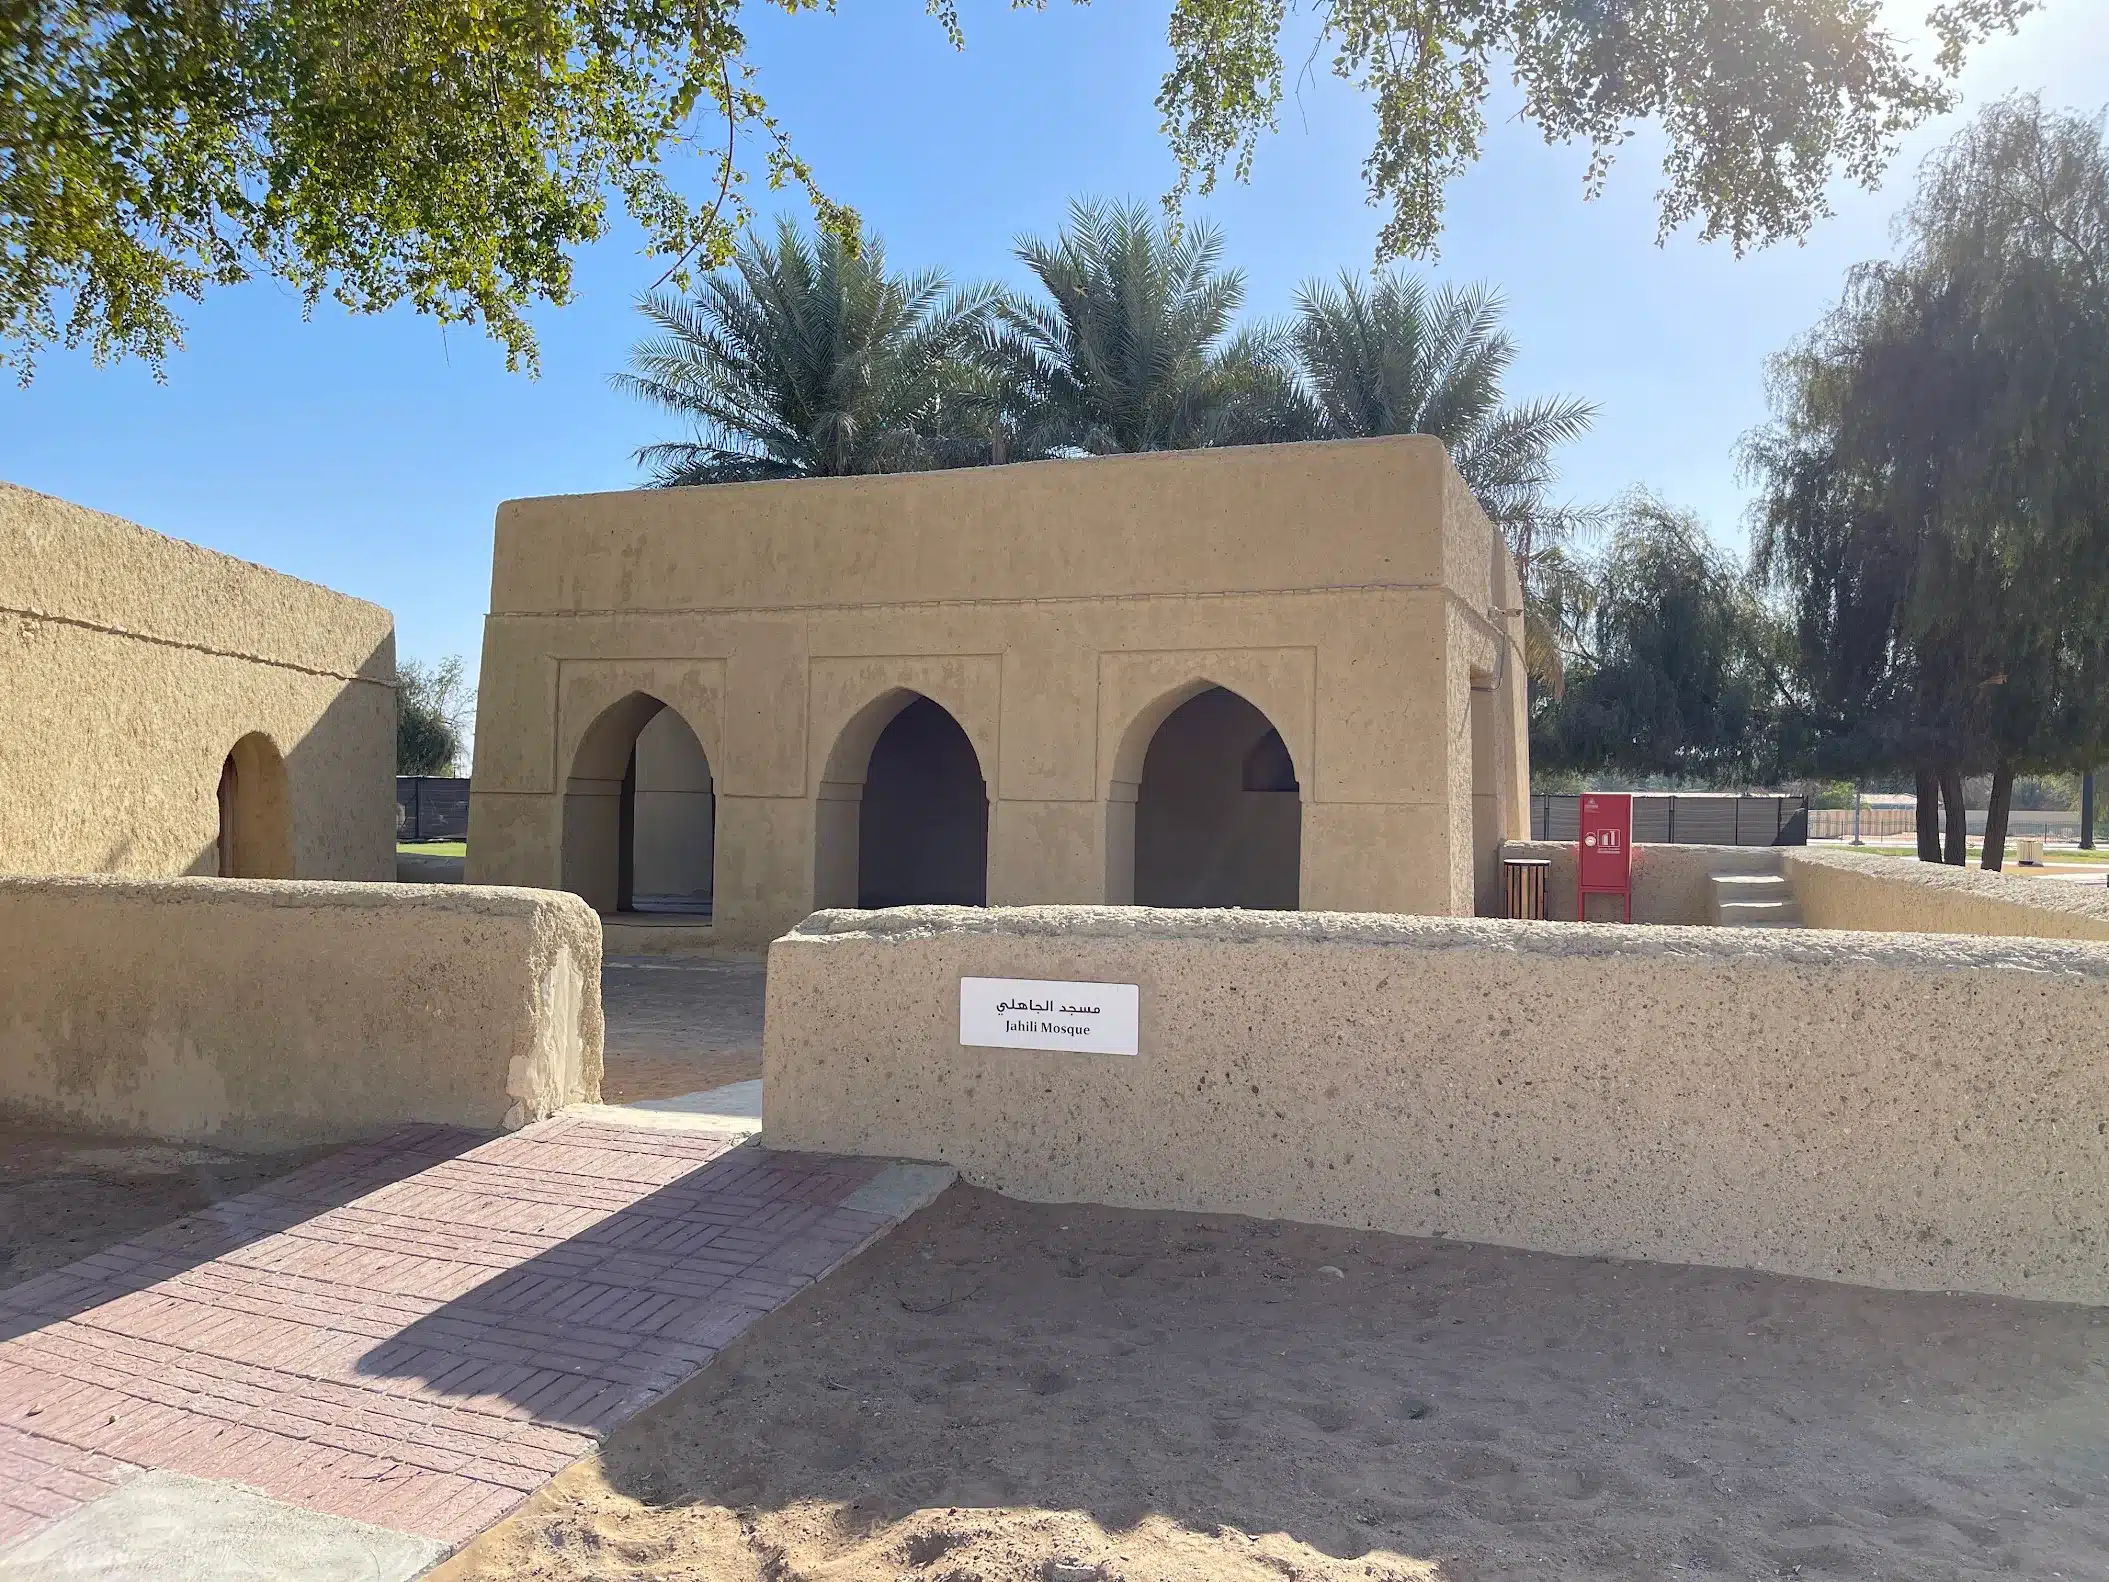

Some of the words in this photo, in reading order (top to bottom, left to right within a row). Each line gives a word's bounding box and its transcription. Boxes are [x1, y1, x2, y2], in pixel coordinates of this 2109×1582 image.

[996, 998, 1054, 1016] الجاهلي
[1058, 1004, 1101, 1016] مسجد
[1005, 1020, 1037, 1033] Jahili
[1040, 1022, 1091, 1037] Mosque
